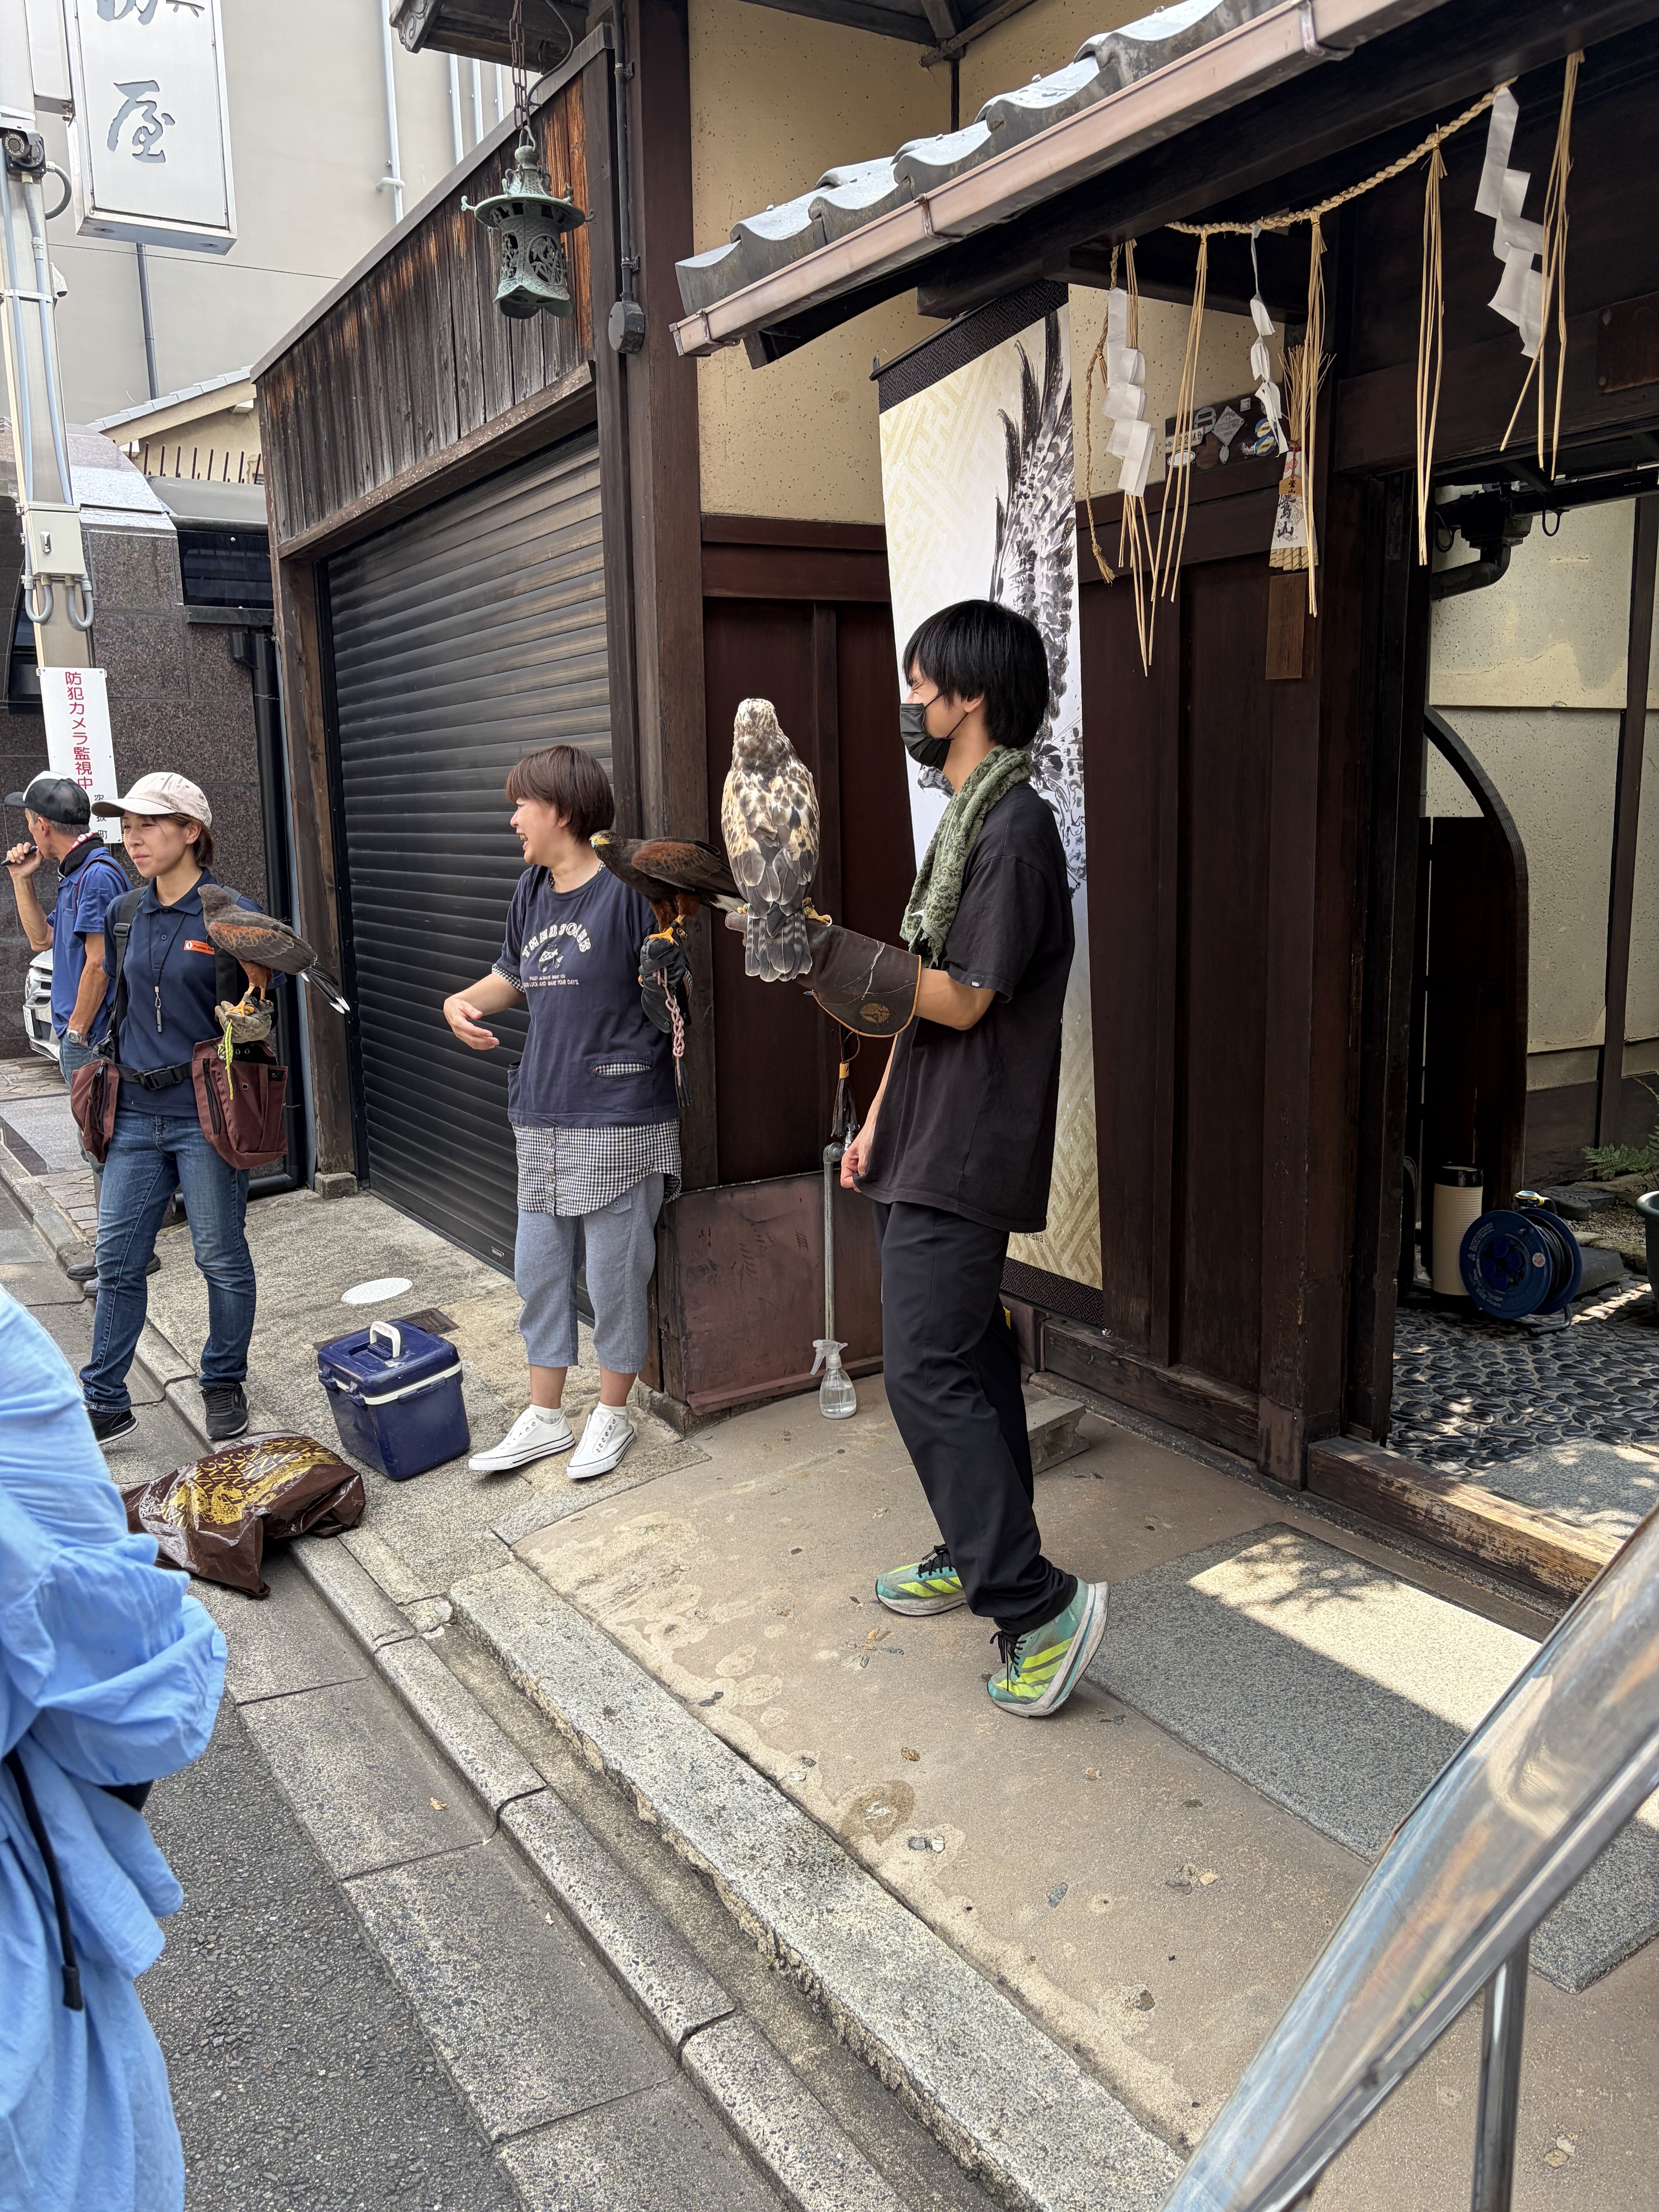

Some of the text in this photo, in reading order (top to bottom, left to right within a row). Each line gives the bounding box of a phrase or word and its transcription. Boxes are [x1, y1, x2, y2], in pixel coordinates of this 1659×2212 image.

[65, 672, 93, 790] 防犯カメラ監視中
